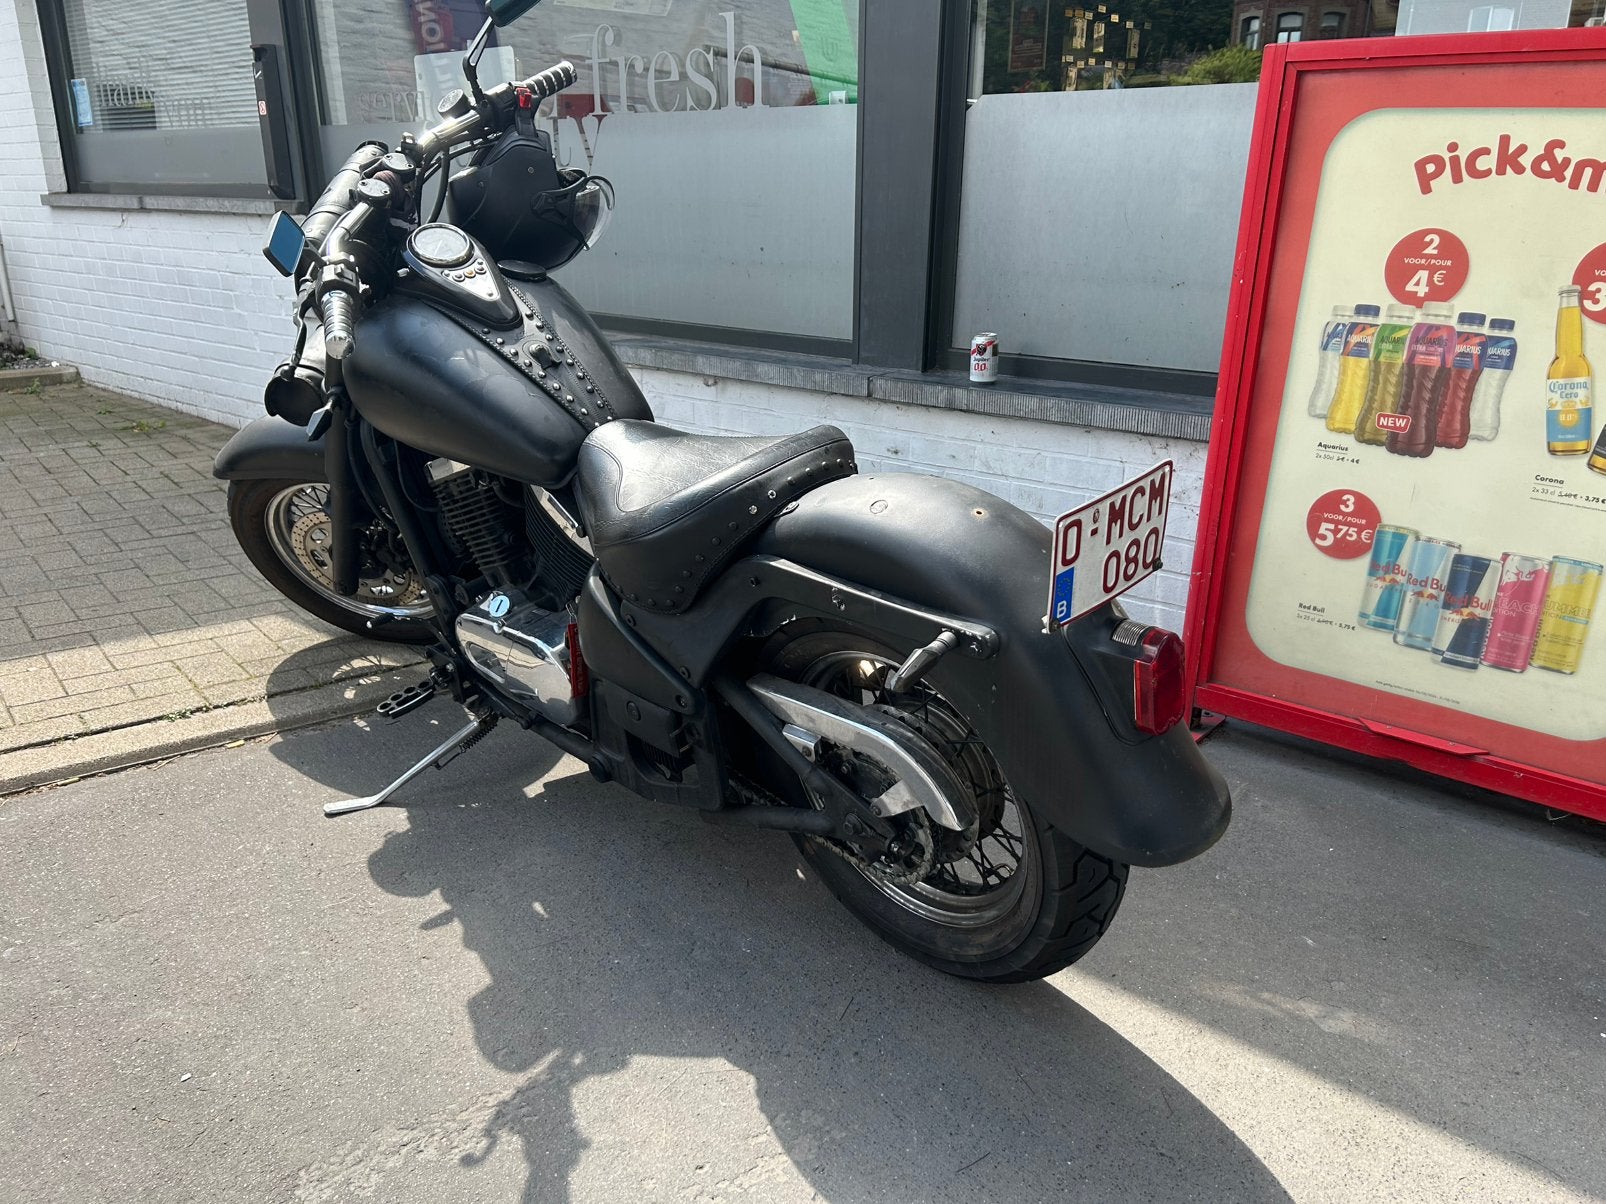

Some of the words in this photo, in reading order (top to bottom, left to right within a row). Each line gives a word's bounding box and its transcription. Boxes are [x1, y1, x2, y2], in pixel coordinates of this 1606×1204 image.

[585, 12, 770, 116] fresh
[1421, 233, 1441, 255] 2
[1403, 257, 1453, 267] VOOR/POUR
[1379, 416, 1407, 428] NEW
[1317, 441, 1349, 453] Aquarius
[1534, 474, 1565, 485] Corona
[1339, 494, 1355, 513] 3
[1323, 512, 1367, 525] VOOR/POUR
[1102, 526, 1160, 594] 080
[1406, 572, 1430, 588] Red
[1056, 600, 1068, 619] B
[1299, 602, 1311, 610] Red
[1312, 605, 1325, 614] Bull
